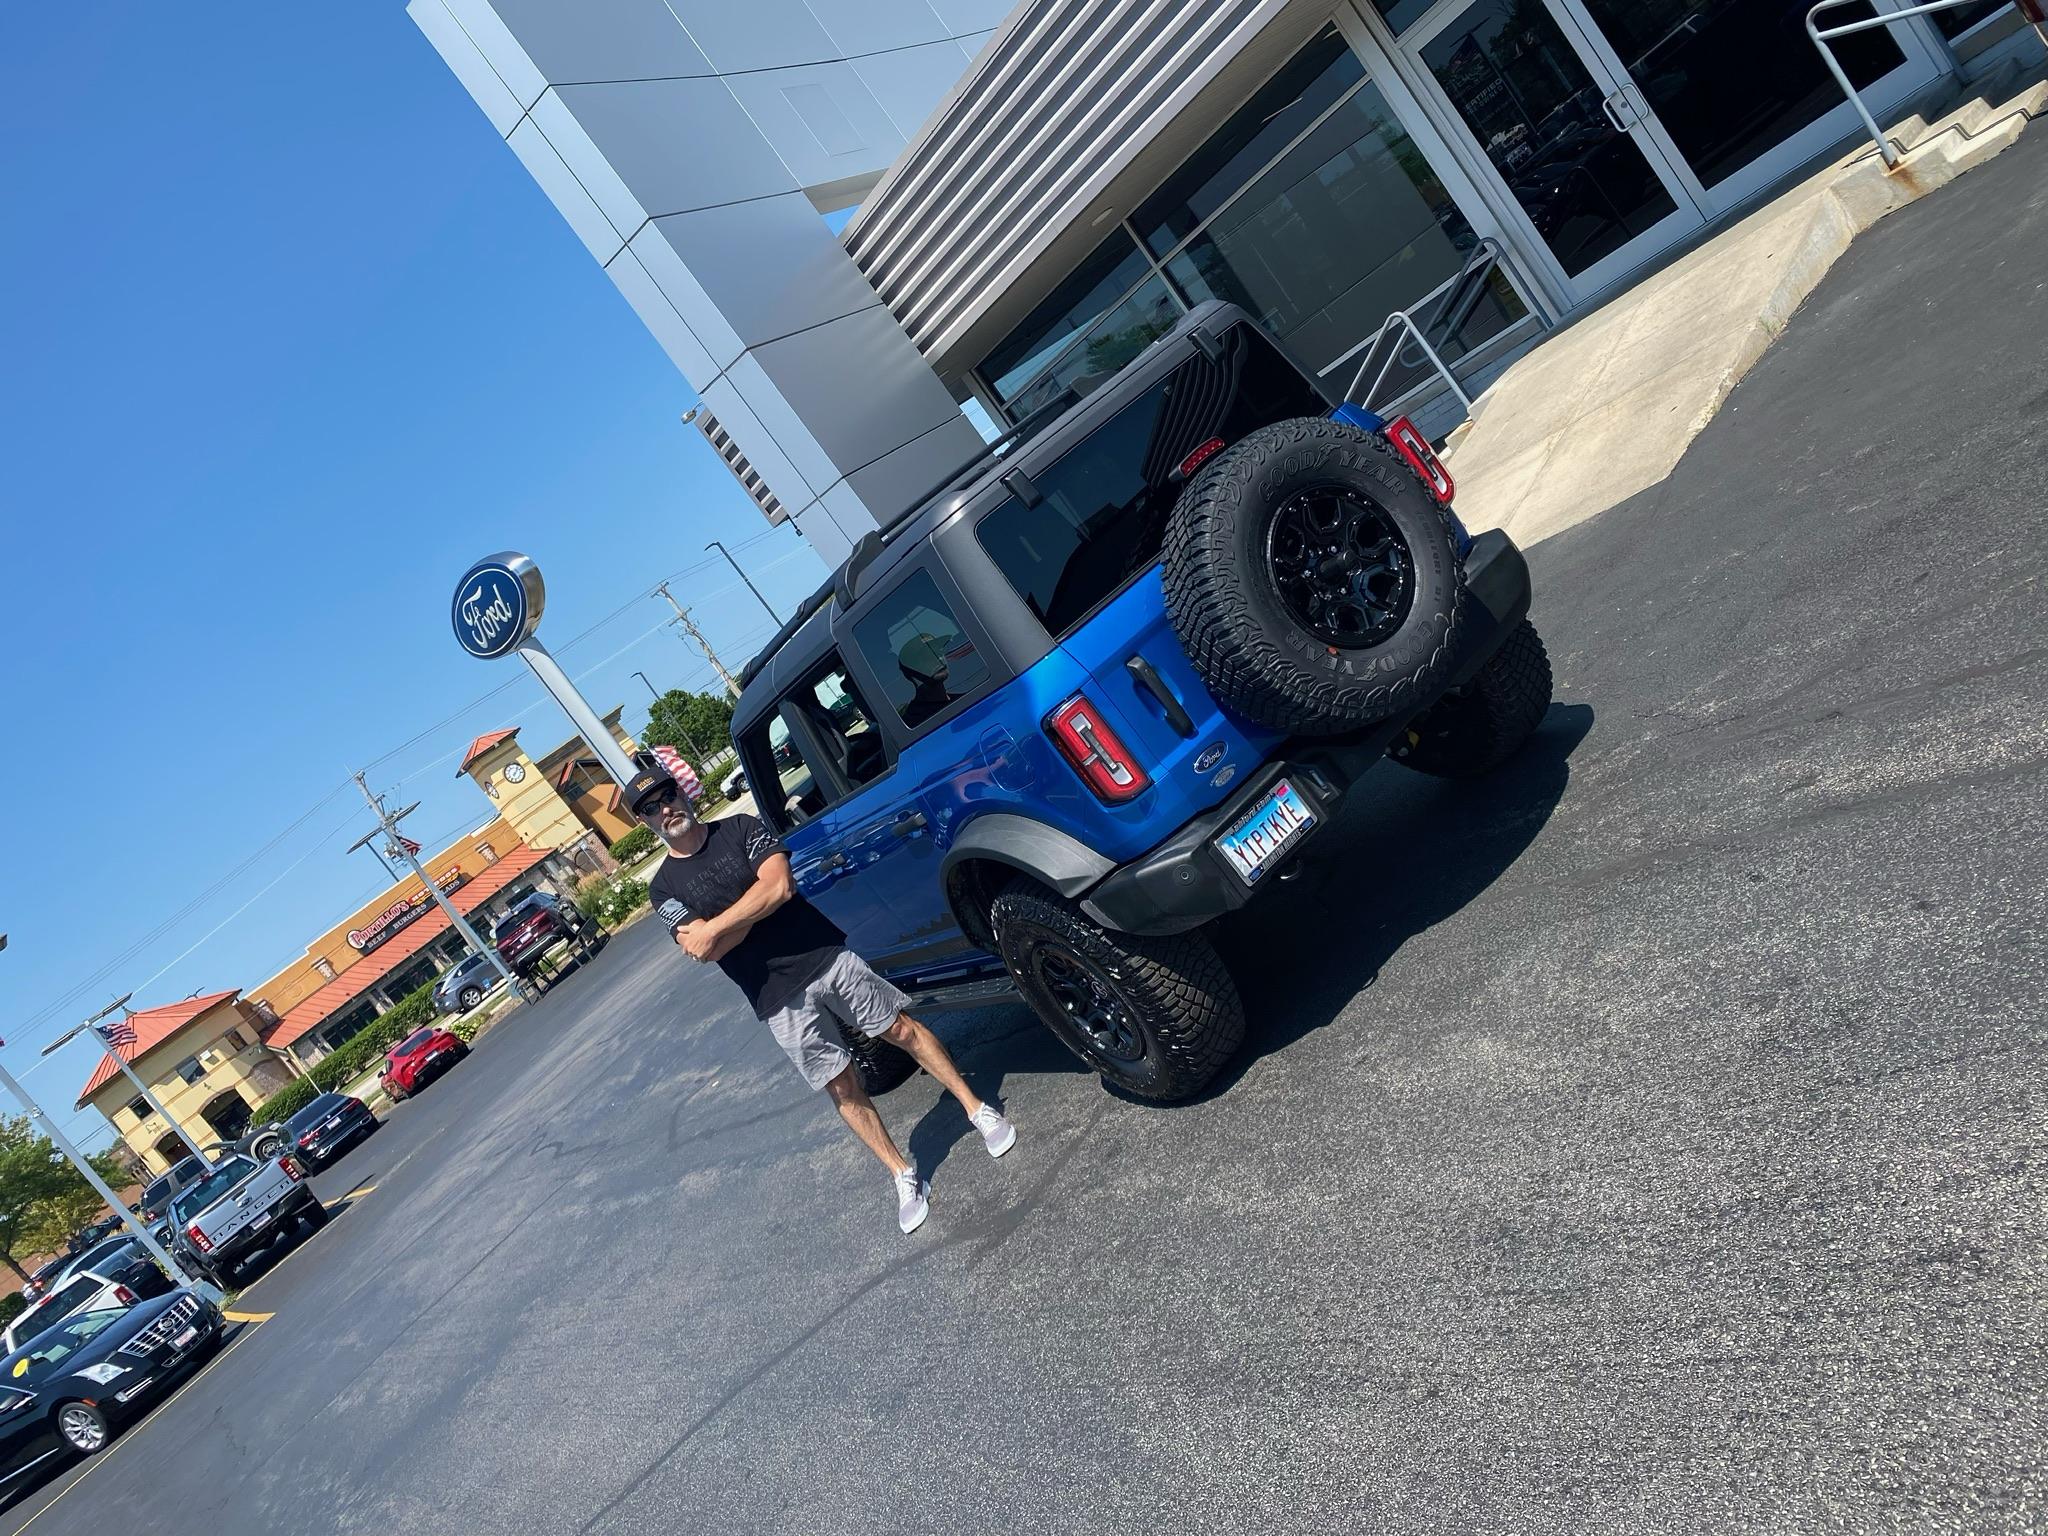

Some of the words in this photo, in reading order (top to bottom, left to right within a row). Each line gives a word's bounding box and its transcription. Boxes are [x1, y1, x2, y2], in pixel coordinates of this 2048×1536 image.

[462, 583, 512, 649] Ford
[1202, 748, 1221, 768] Ford
[1233, 798, 1304, 869] YIPIKYE
[350, 900, 410, 946] PORTILLO'S
[366, 931, 387, 949] BEEF
[392, 903, 427, 929] BURGERS
[213, 1180, 290, 1241] RANGER
